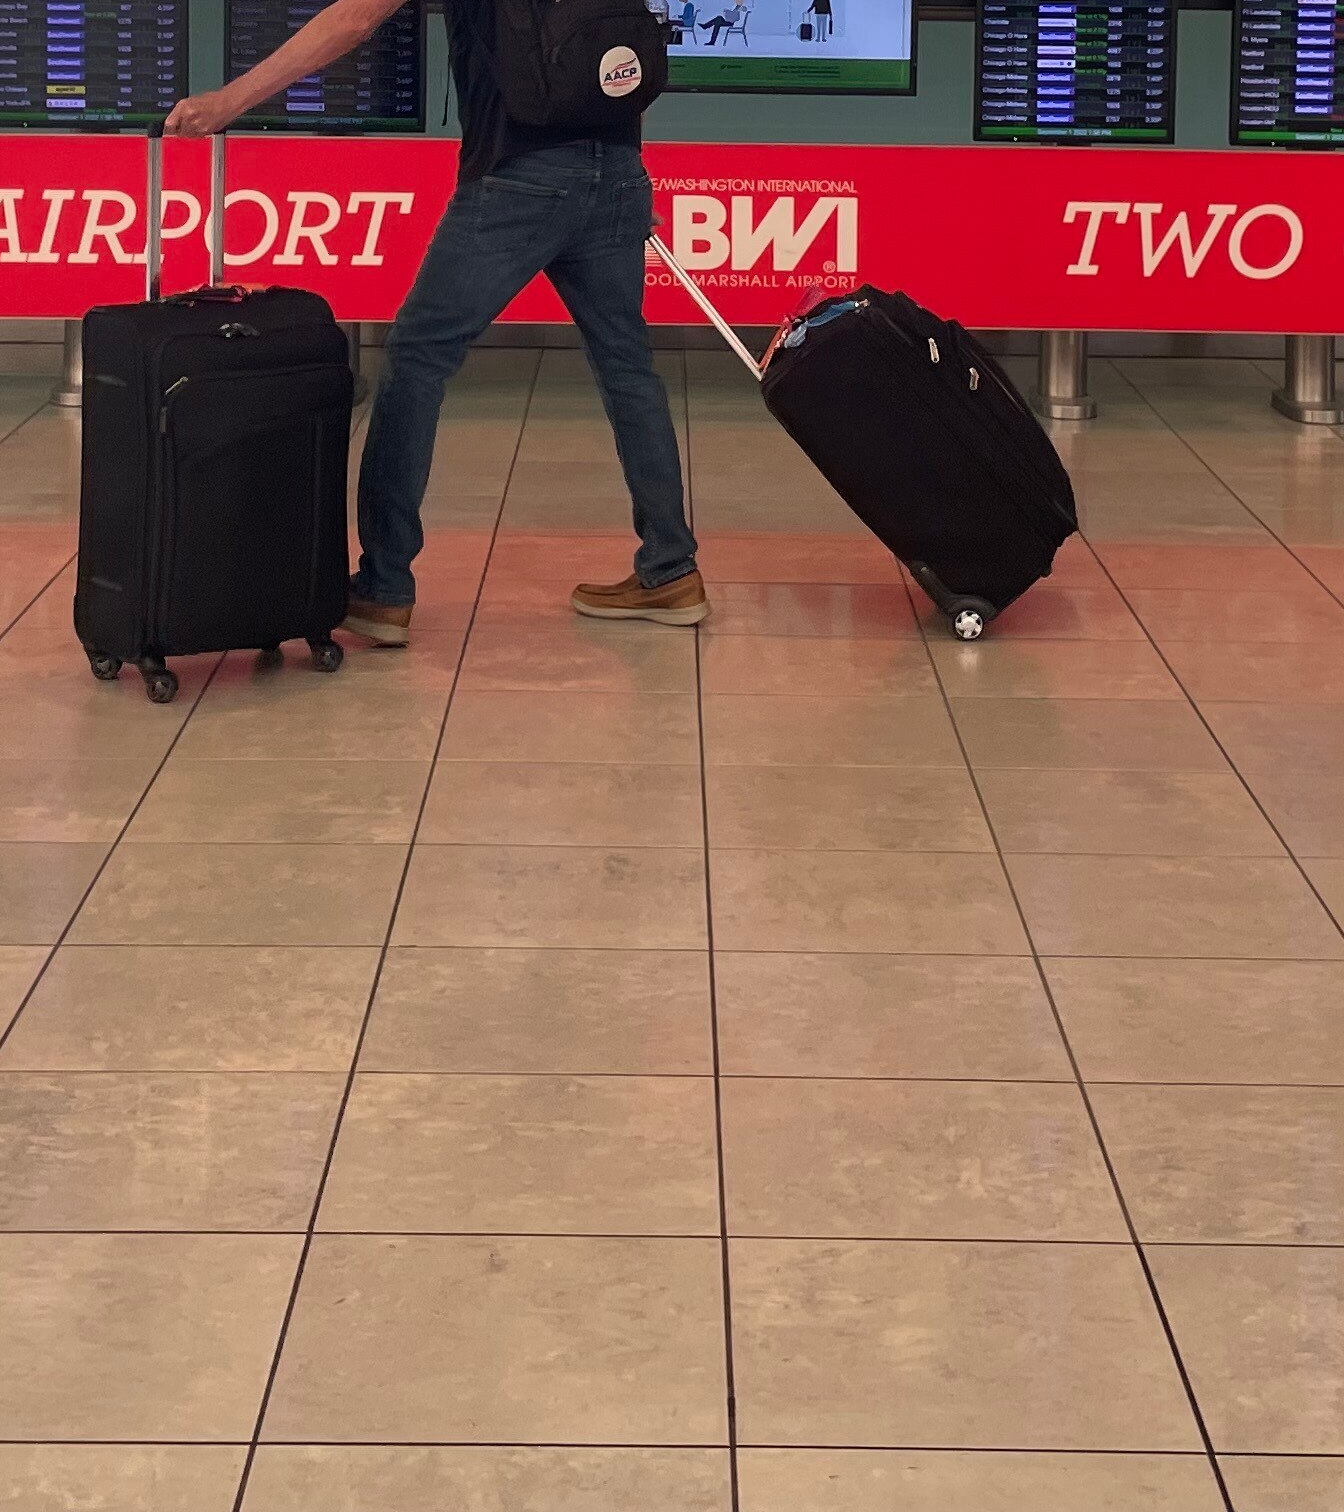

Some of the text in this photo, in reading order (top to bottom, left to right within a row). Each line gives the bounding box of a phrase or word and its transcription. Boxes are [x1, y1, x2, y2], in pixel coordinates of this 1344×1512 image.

[604, 67, 637, 82] AACP
[652, 178, 858, 193] E/WASHINGTON INTERNATIONAL
[672, 194, 858, 272] BWI
[1063, 201, 1303, 280] TWO
[695, 274, 780, 288] MARSHALL
[786, 275, 856, 289] AIRPORT
